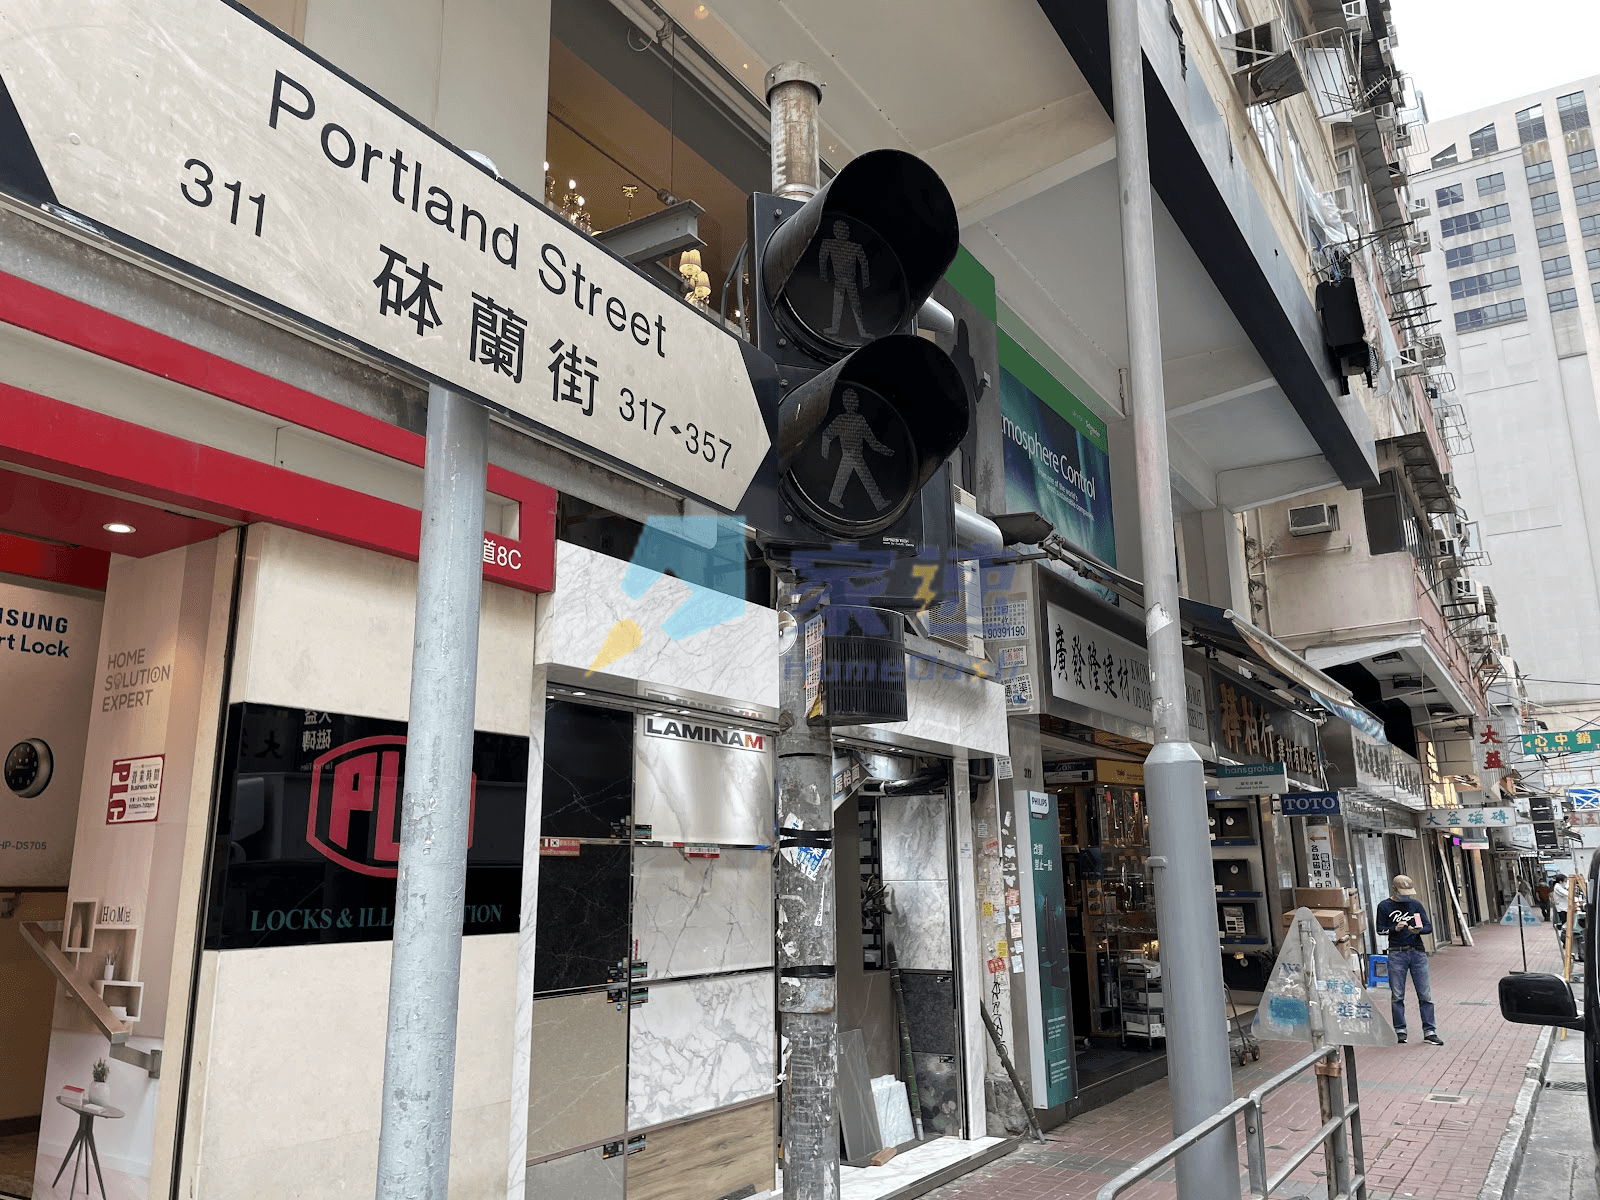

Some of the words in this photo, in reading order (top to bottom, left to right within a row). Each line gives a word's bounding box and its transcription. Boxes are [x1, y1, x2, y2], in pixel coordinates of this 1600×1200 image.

[180, 157, 267, 238] 311
[268, 69, 519, 270] Portland
[538, 244, 667, 358] Street
[372, 244, 599, 417] 砵蘭街
[1060, 454, 1096, 500] Control
[0, 607, 68, 634] SUNG
[987, 624, 1026, 638] 90391190
[20, 634, 70, 658] Lock
[108, 648, 146, 670] HOME
[1053, 623, 1130, 703] 廣發隆建材
[102, 689, 154, 712] EXPERT
[646, 718, 764, 750] LAMINAM
[1225, 763, 1275, 774] hansgrohe
[1031, 796, 1048, 807] PHILIPS
[1283, 797, 1336, 811] TOTO
[1426, 808, 1509, 826] 大益磁磚
[250, 908, 333, 932] LOCKS
[336, 907, 354, 929] &
